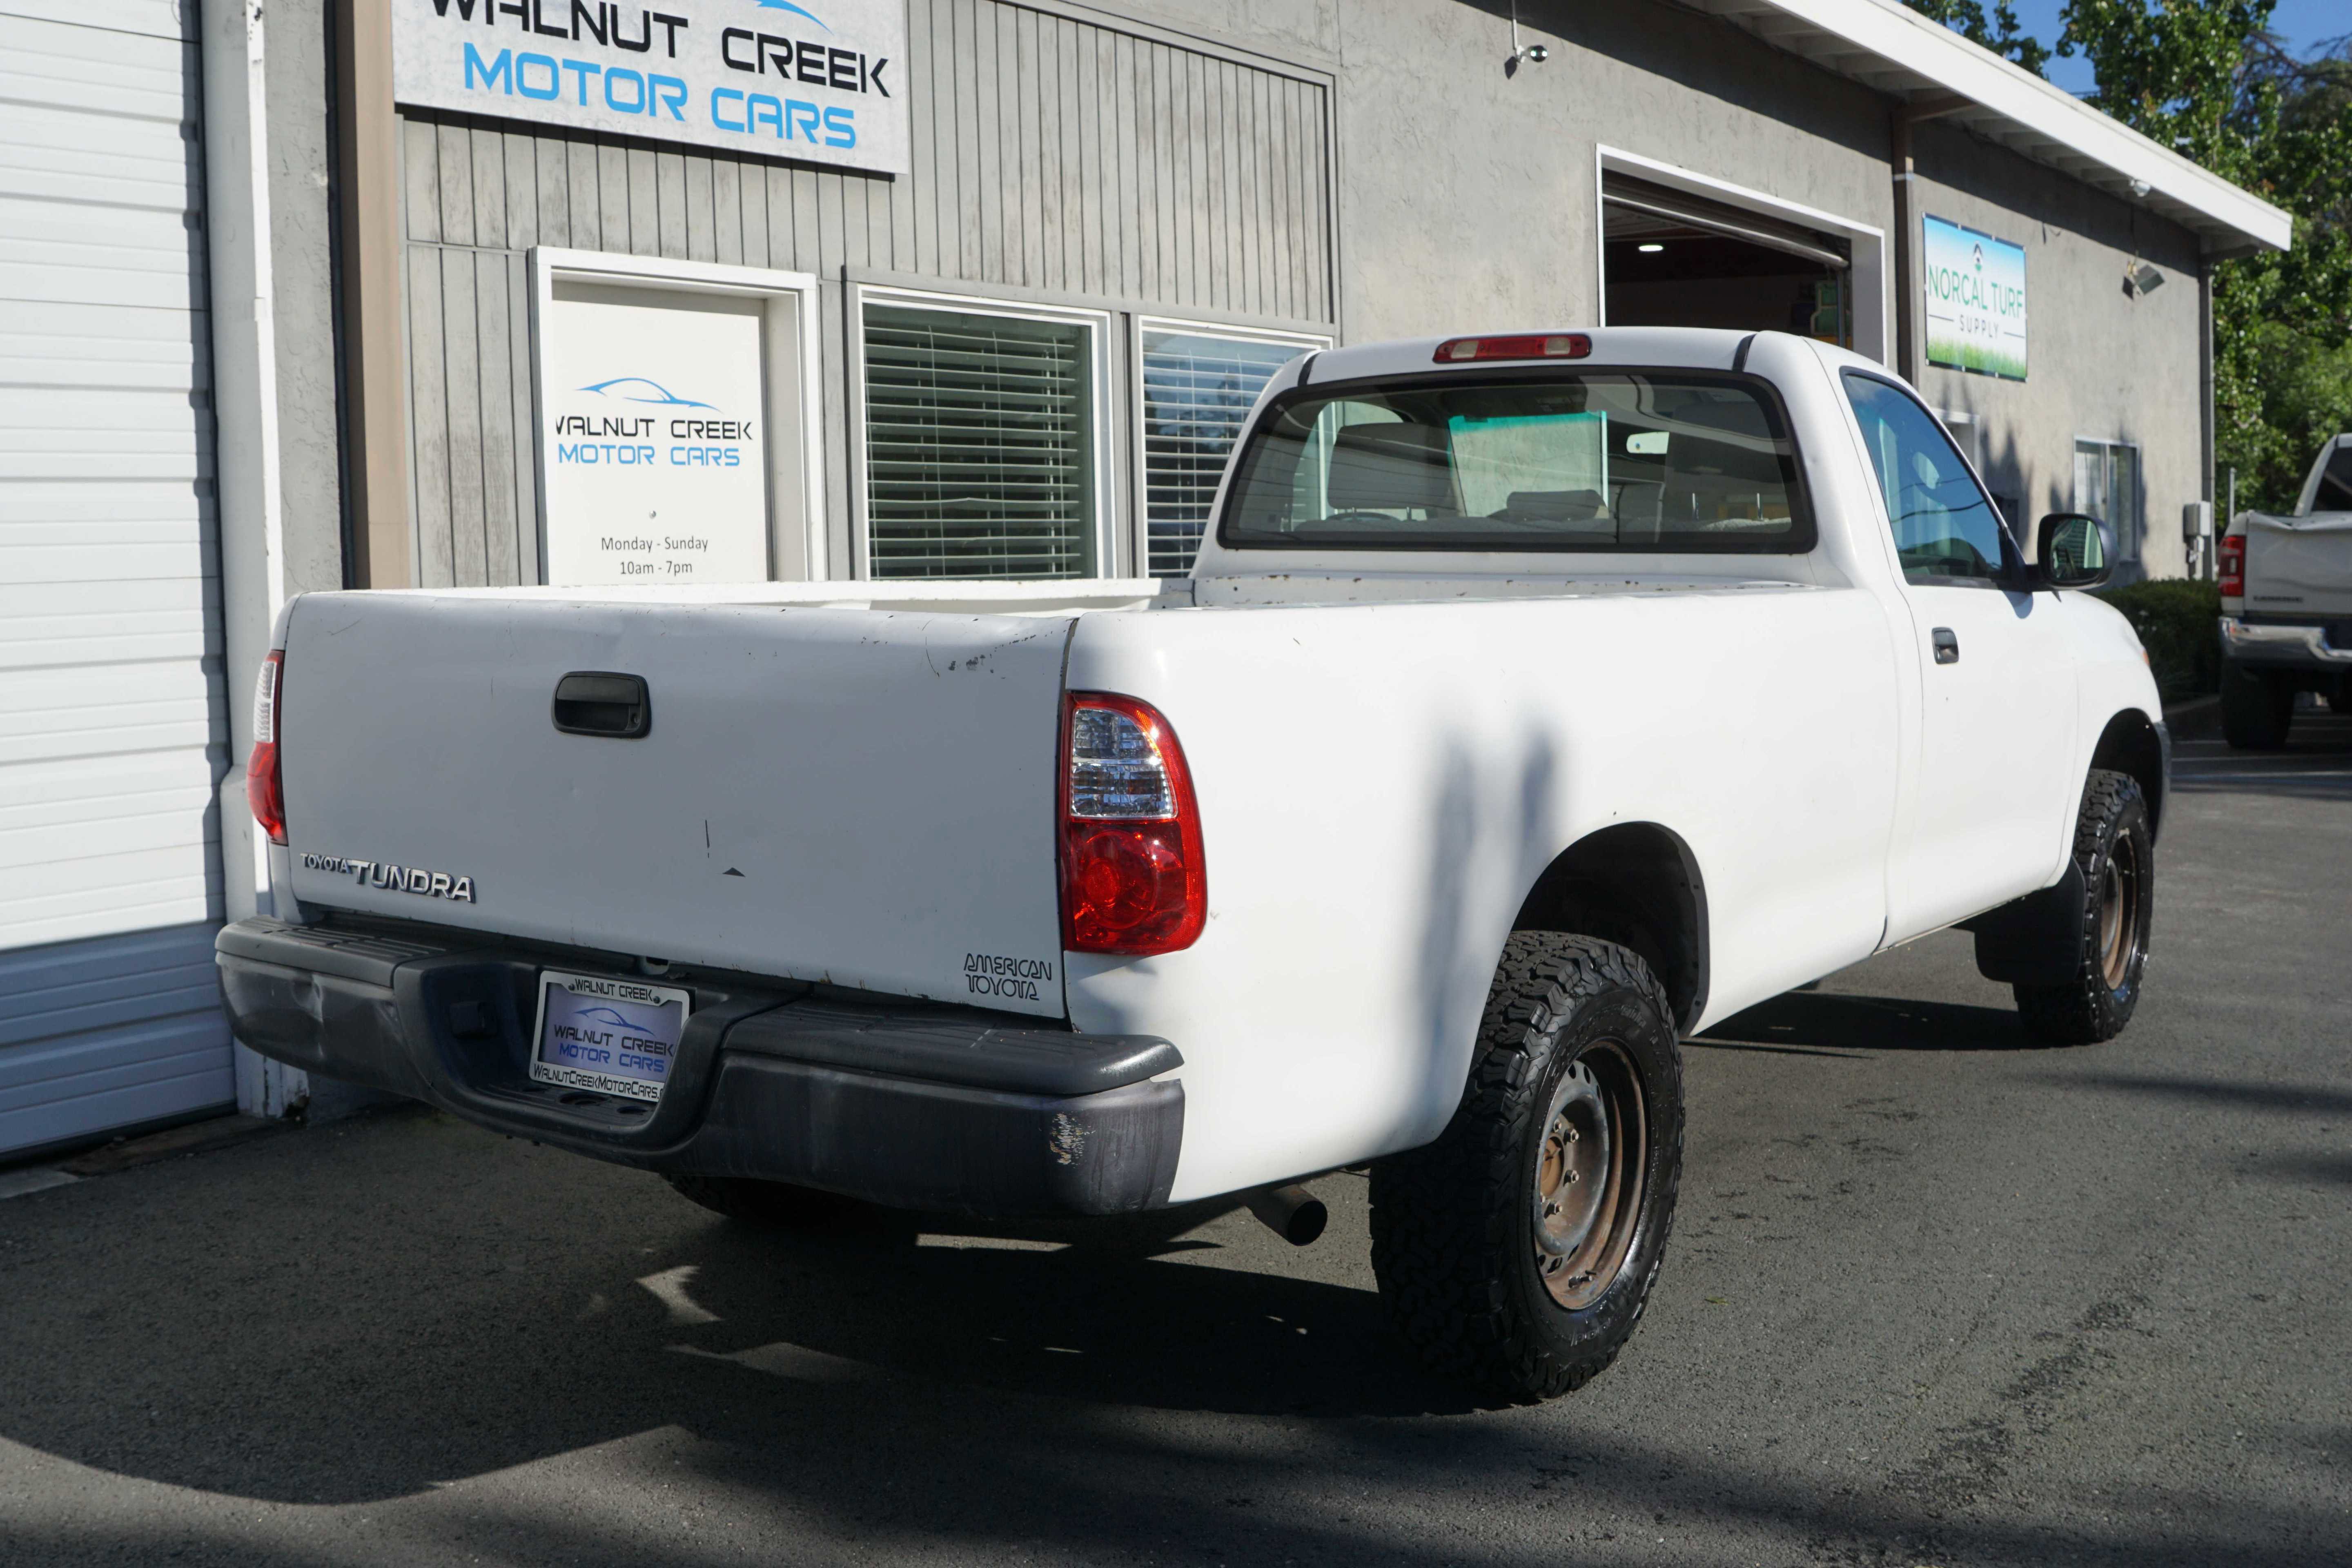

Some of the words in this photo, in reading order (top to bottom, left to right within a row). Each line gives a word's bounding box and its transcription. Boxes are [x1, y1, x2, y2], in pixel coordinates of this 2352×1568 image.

[722, 27, 890, 98] CREEK
[463, 42, 688, 121] MOTOR
[711, 87, 856, 149] CARS
[1929, 265, 1988, 310] NORCAL
[1991, 281, 2023, 318] TURF
[1960, 314, 1999, 339] SUPPLY
[670, 419, 753, 440] CREEK
[558, 443, 655, 465] MOTOR
[670, 447, 740, 466] CARS
[601, 537, 653, 553] Monday
[665, 536, 708, 552] Sunday
[620, 561, 654, 575] 10am
[666, 561, 693, 577] 7pm
[300, 853, 351, 874] TOYOTA
[347, 859, 476, 903] TUNDRA
[964, 953, 1052, 981] AMERICAN
[575, 978, 615, 996] WALNUT
[619, 985, 654, 1001] CREEK
[965, 974, 1040, 1001] TOYOTA
[554, 1024, 613, 1046] WALNUT
[621, 1036, 673, 1057] CREEK
[559, 1042, 610, 1064] MOTOR
[619, 1053, 665, 1073] CARS
